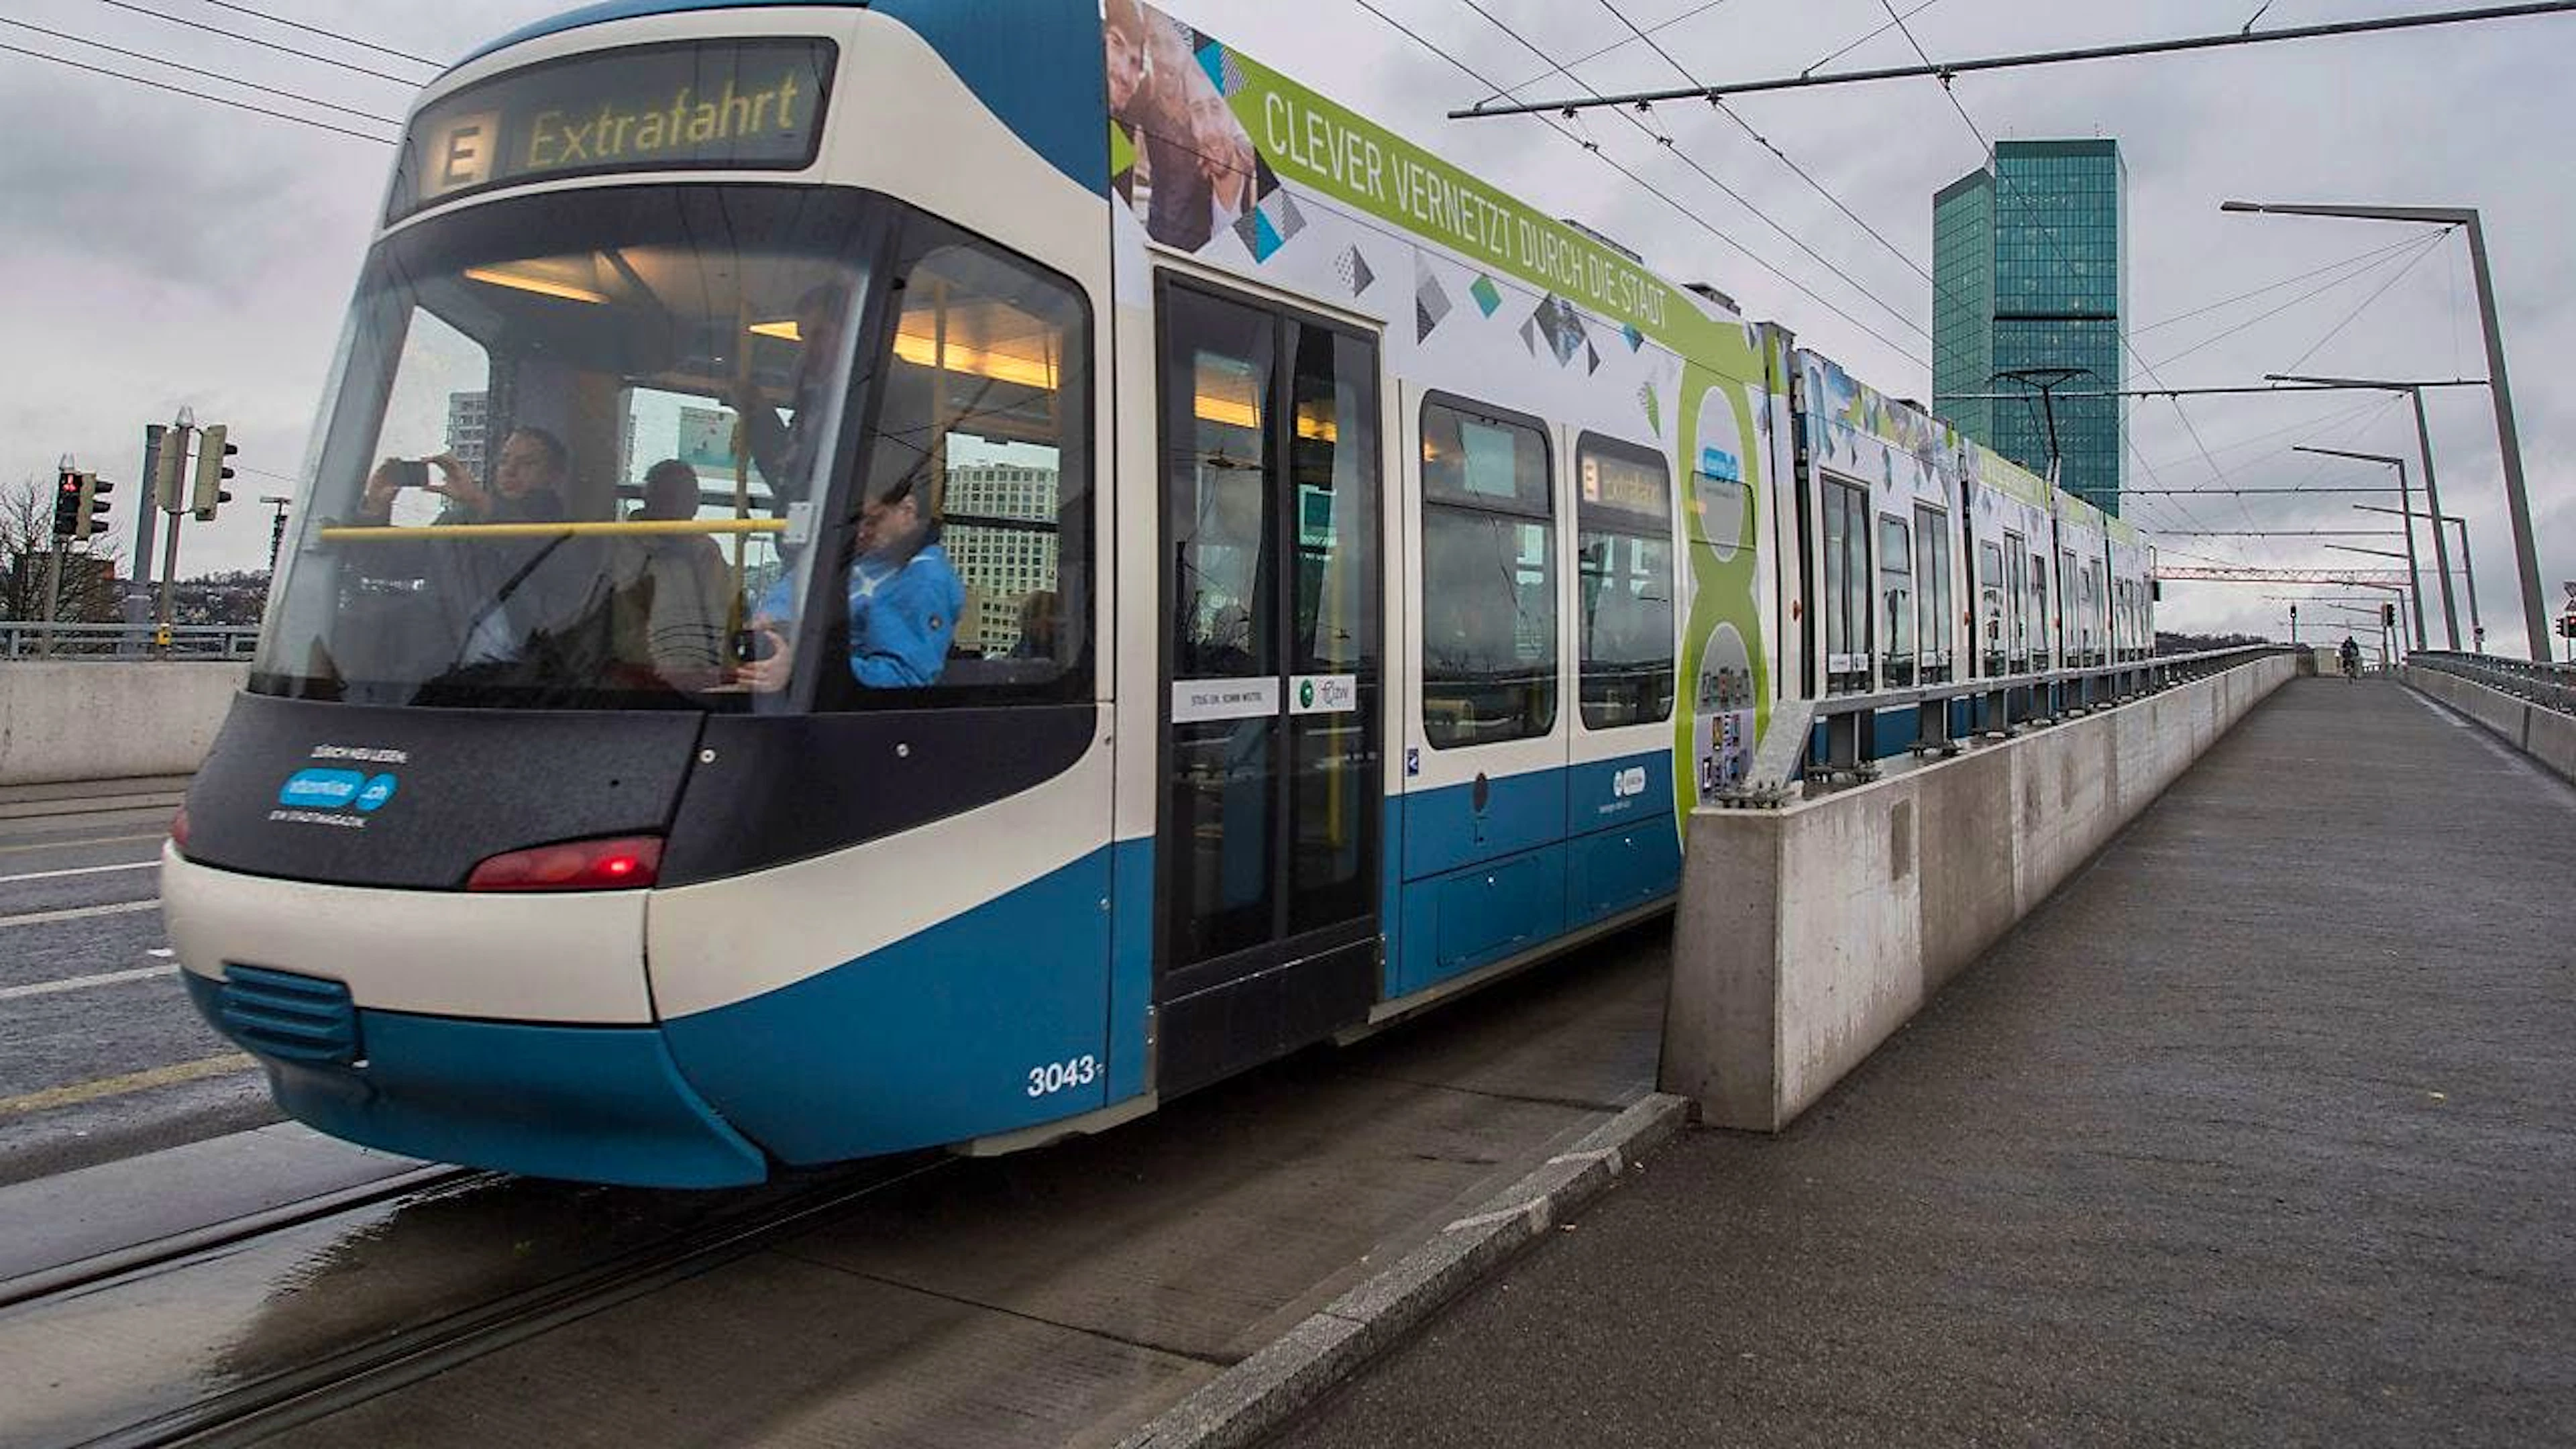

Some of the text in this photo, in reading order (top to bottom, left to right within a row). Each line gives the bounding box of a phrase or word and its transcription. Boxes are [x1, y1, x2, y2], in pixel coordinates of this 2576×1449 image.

[443, 72, 798, 186] E Extrafahrt
[1265, 92, 1668, 330] CLEVER VERNETZT DURCH DIE STADT
[1027, 1054, 1095, 1097] 3043
